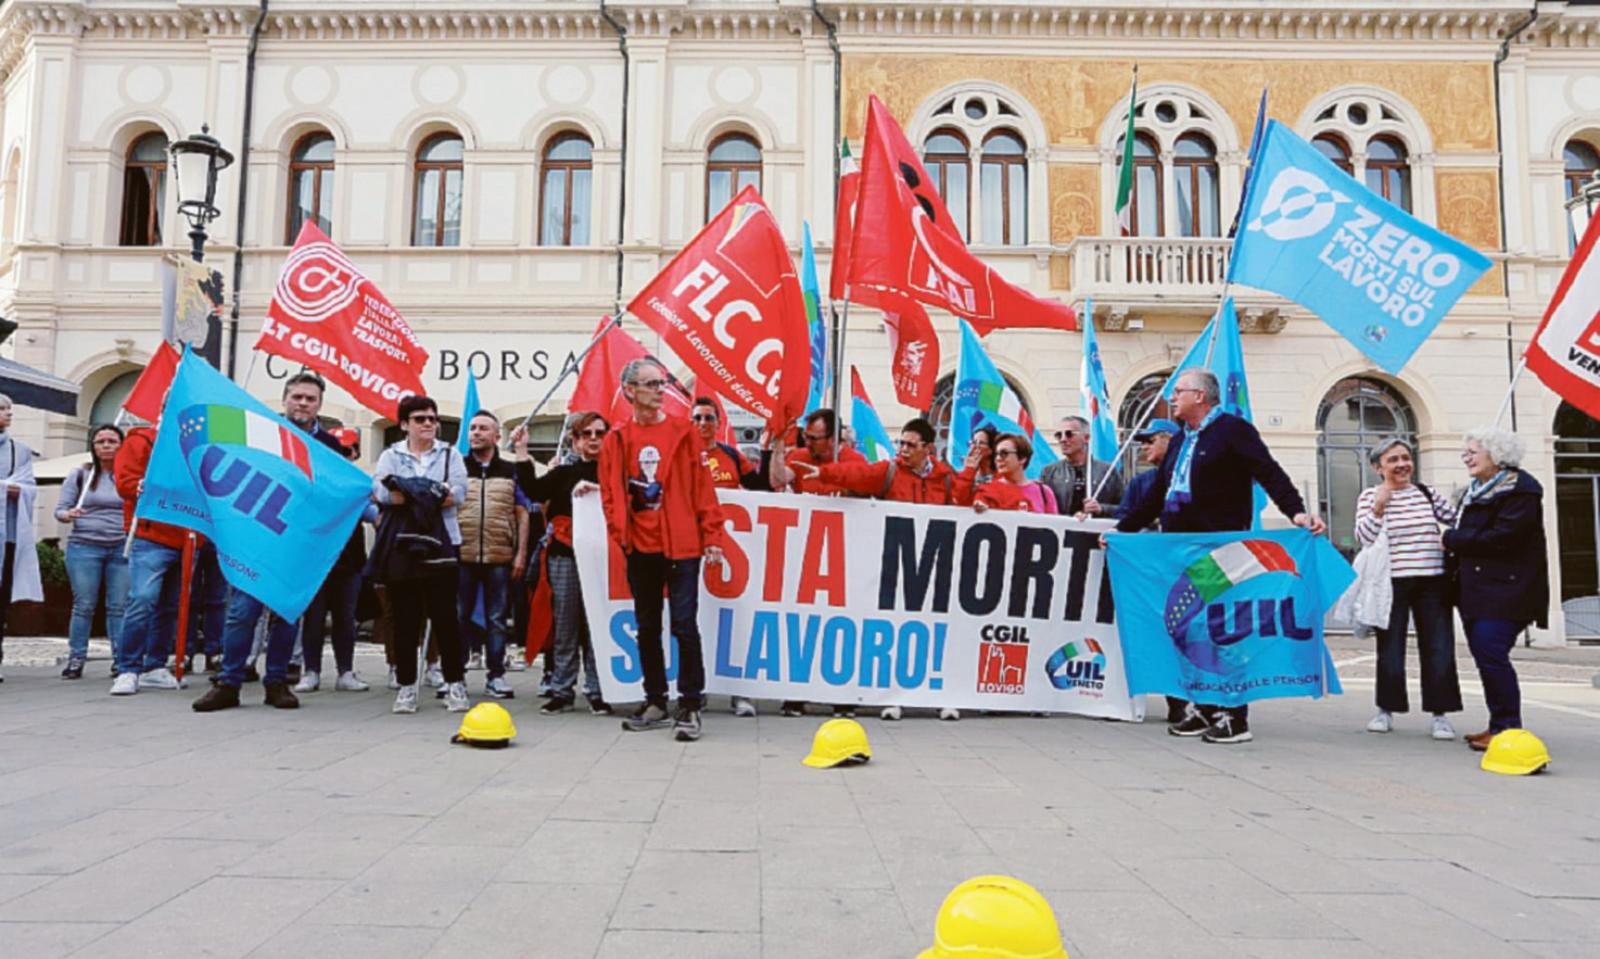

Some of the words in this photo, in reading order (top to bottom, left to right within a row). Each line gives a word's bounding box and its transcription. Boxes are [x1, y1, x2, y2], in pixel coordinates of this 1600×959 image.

[1332, 228, 1397, 285] MORTI
[1396, 276, 1437, 309] SUL
[1343, 204, 1460, 287] ZERO
[672, 259, 763, 349] FLC
[1318, 242, 1425, 327] LAVORO
[290, 332, 340, 366] CGIL
[439, 350, 581, 381] BORSA
[685, 330, 737, 383] Lavoratori
[199, 445, 292, 536] UIL
[608, 503, 846, 607] STA
[715, 607, 948, 690] LAVORO!
[980, 624, 1030, 643] CGIL
[1207, 596, 1313, 646] UIL
[1066, 660, 1104, 681] UIL
[1066, 678, 1104, 690] VENETO
